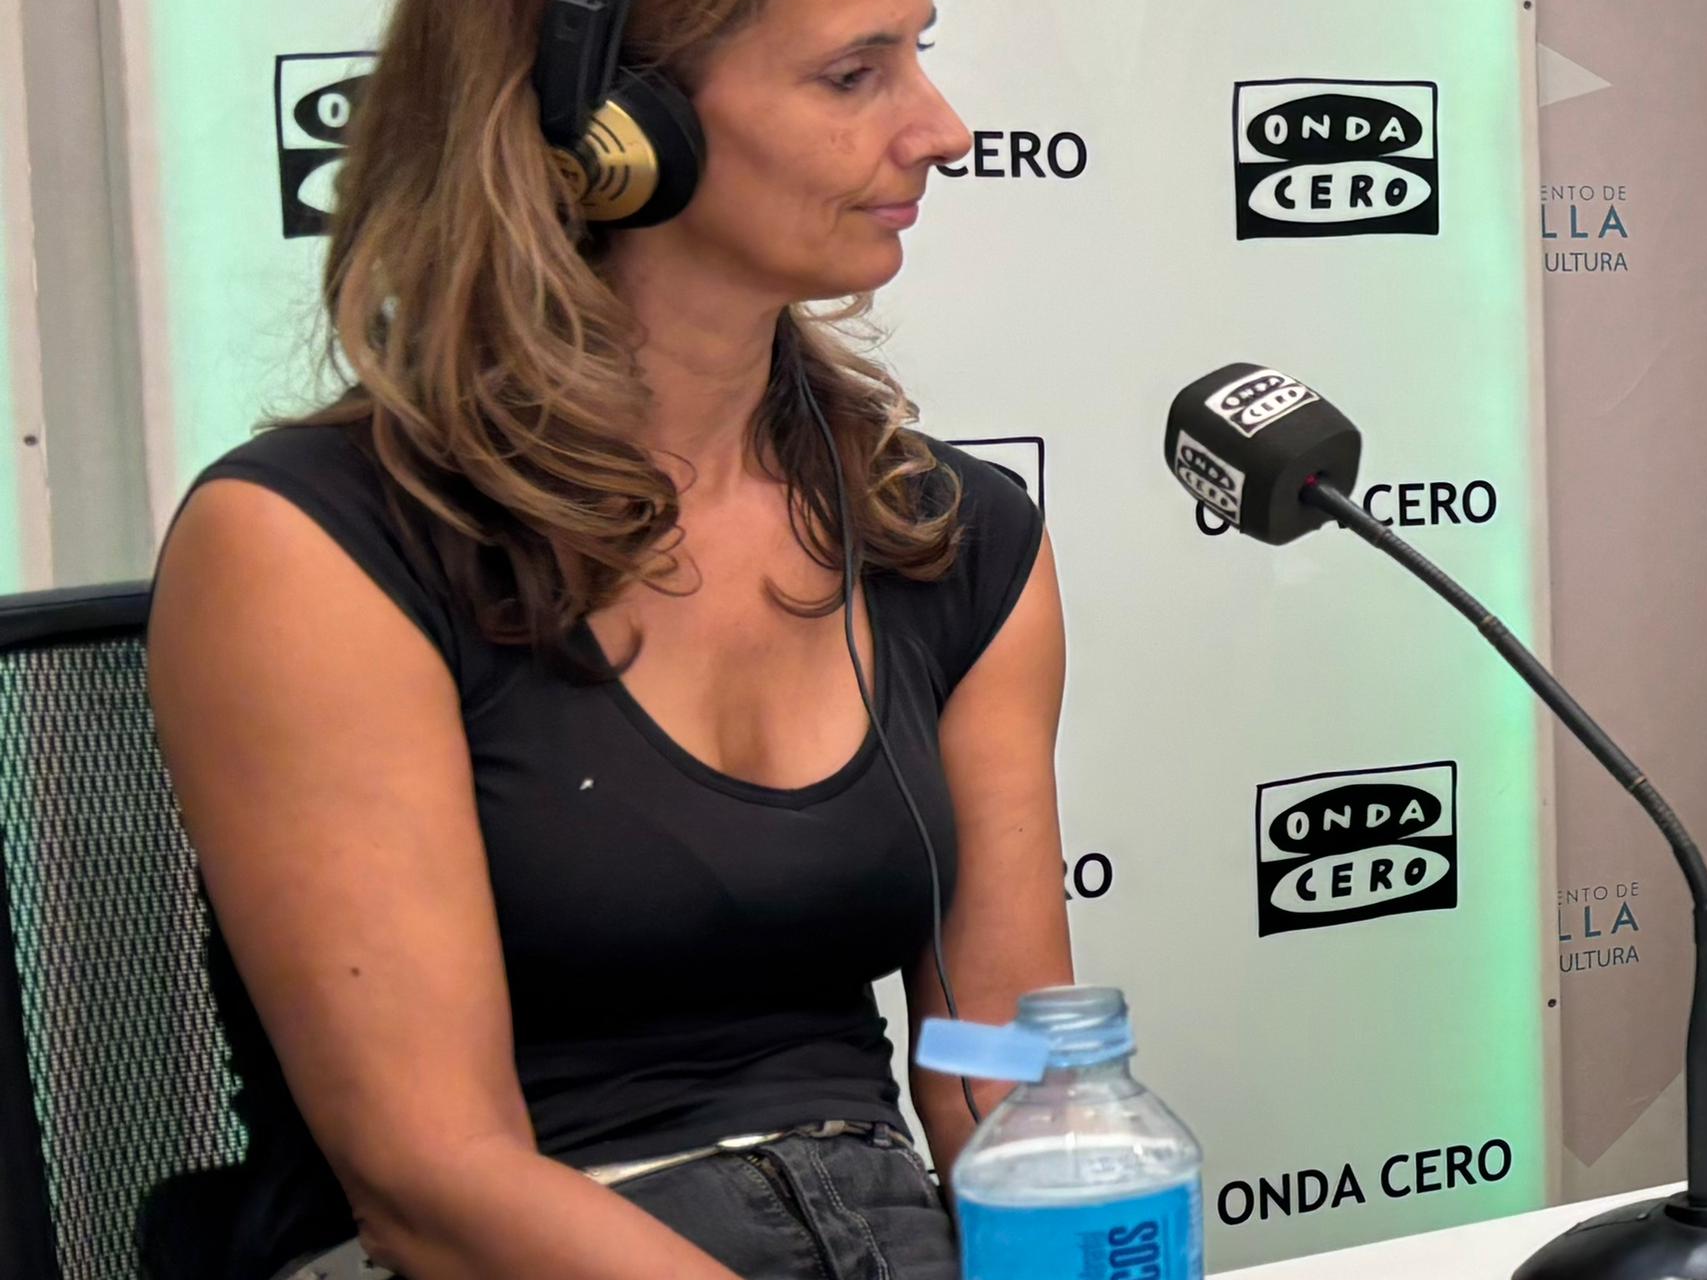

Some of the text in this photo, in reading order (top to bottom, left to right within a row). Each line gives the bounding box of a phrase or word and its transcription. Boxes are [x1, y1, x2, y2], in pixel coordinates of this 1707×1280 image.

[1264, 114, 1406, 145] ONDA
[1274, 173, 1408, 210] CERO
[1603, 185, 1626, 201] DE
[1544, 251, 1629, 272] ULTURA
[1225, 376, 1282, 407] ONDA
[1249, 389, 1298, 417] CERO
[1363, 479, 1498, 527] CERO
[1286, 798, 1426, 841] ONDA
[1296, 856, 1428, 902] CERO
[1616, 881, 1639, 898] DE
[1559, 945, 1640, 973] ULTURA
[1217, 1138, 1513, 1226] ONDA CERO
